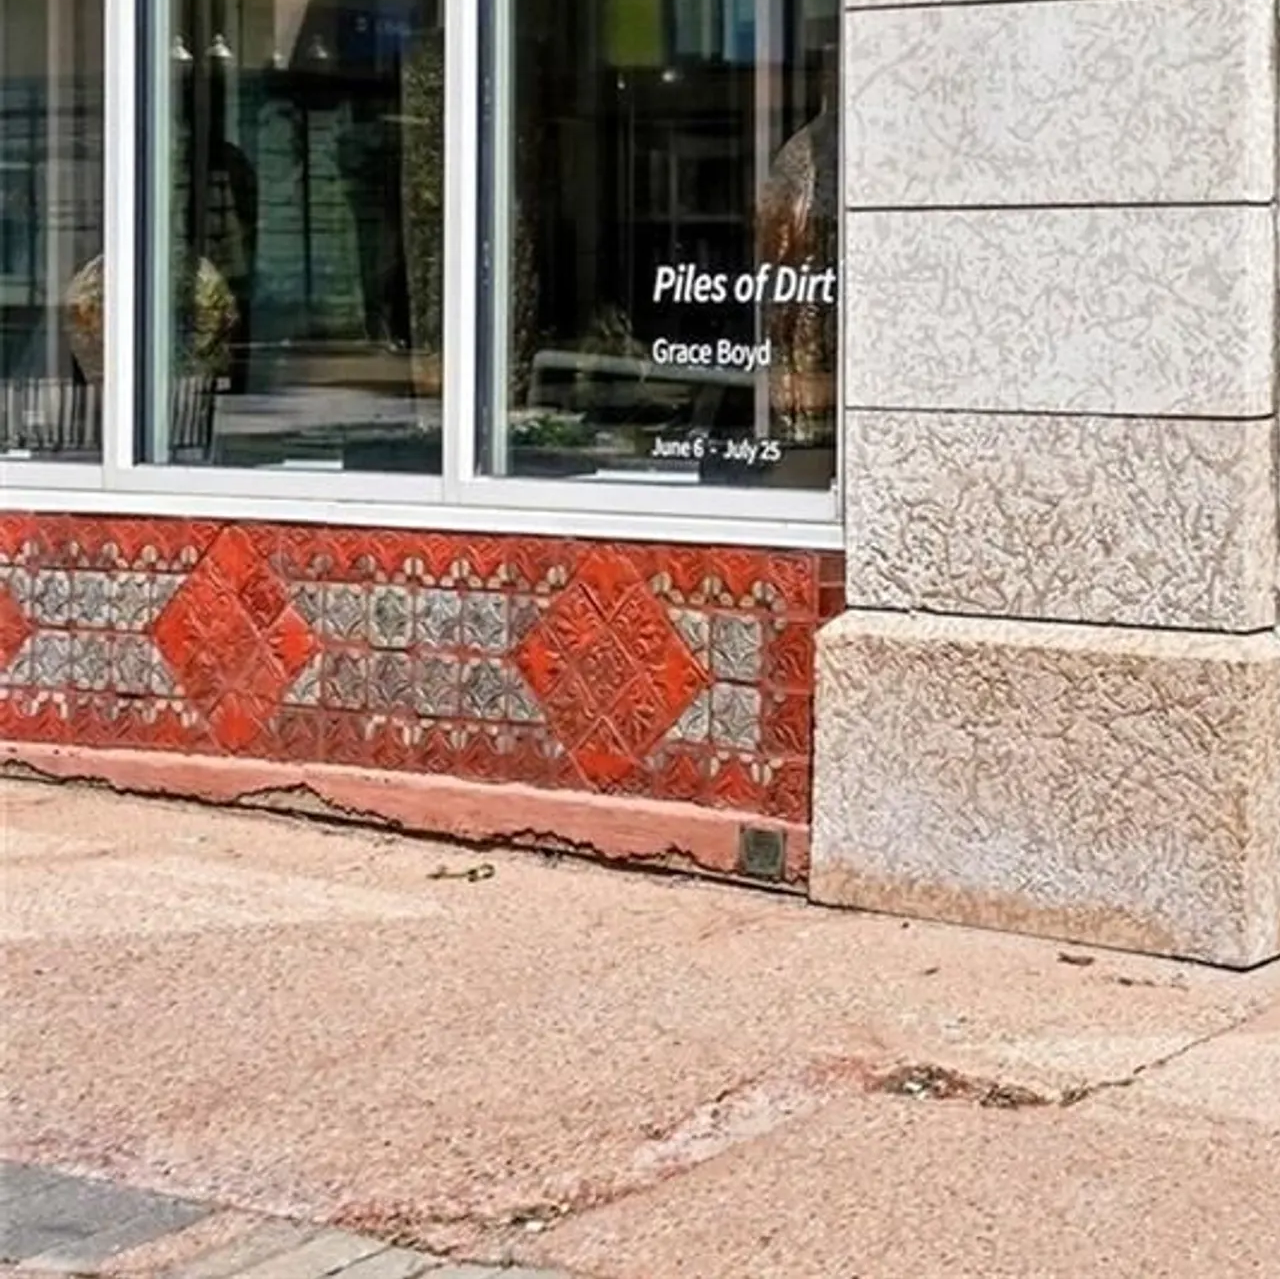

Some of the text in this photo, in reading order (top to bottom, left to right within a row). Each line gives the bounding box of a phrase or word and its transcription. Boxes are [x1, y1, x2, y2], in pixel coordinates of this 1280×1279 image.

[652, 263, 836, 303] Piles of Dirt
[652, 338, 771, 371] Grace Boyd
[652, 437, 690, 458] June
[693, 438, 704, 458] 6
[723, 439, 758, 464] July
[760, 441, 781, 460] 25
